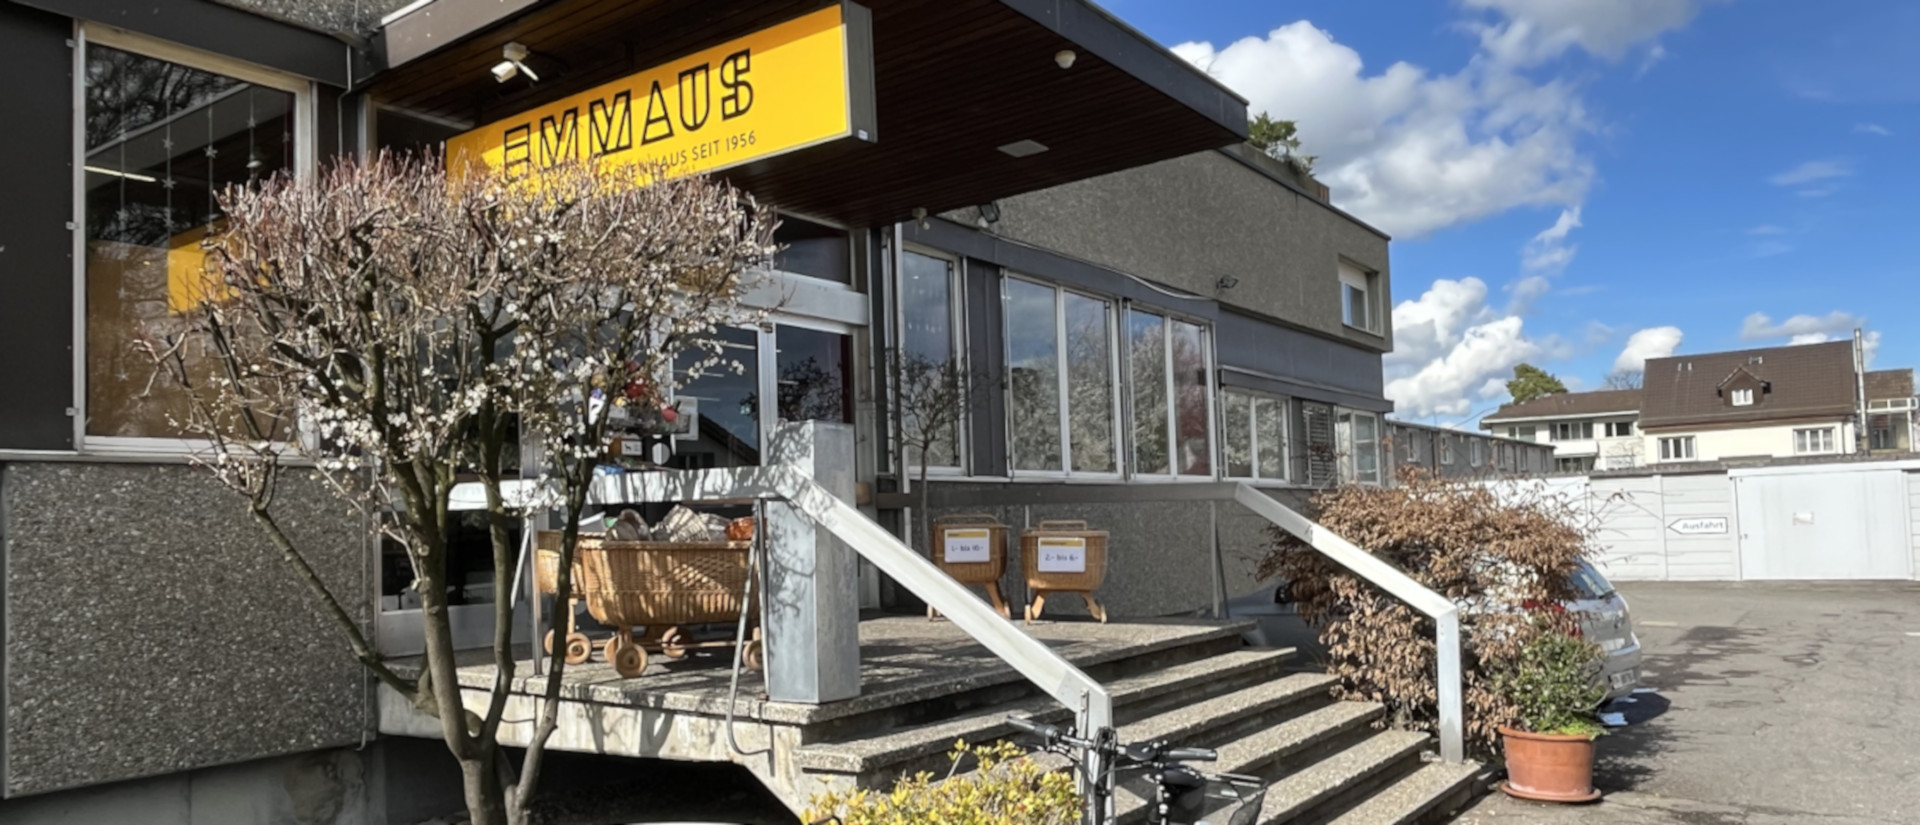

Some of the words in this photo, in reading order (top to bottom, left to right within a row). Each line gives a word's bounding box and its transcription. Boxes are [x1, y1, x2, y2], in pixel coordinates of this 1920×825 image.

[504, 48, 754, 183] EMMAUS
[691, 139, 720, 162] SEIT
[725, 130, 757, 152] 1956
[1682, 521, 1724, 530] Ausfahrt
